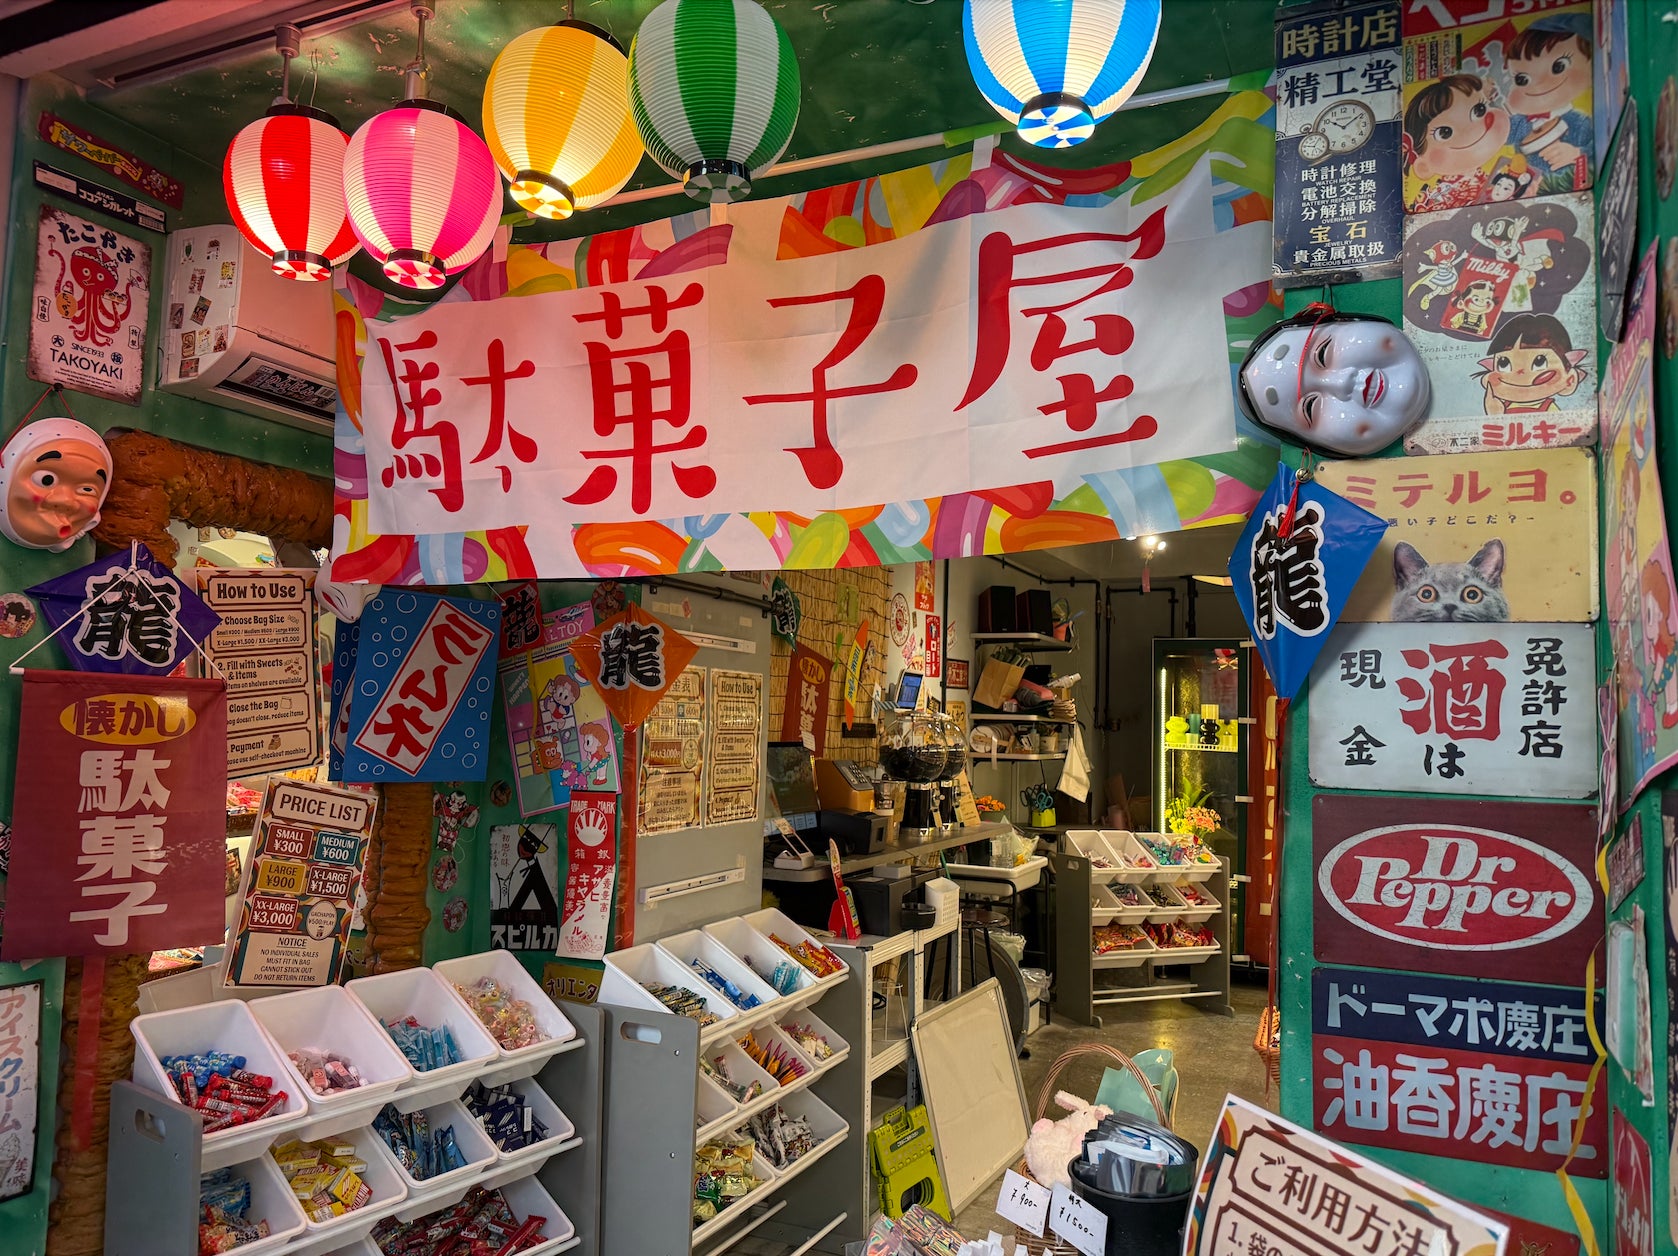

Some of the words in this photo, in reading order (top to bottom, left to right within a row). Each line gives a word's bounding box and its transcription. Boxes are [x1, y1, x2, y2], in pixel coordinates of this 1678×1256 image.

[1282, 8, 1399, 59] 時計店
[1283, 59, 1398, 109] 精工堂
[1301, 159, 1377, 182] 時計修理
[1315, 178, 1338, 187] WATCH
[1339, 175, 1362, 184] REPAIR
[1301, 179, 1377, 201] 電池交換
[79, 188, 135, 217] ココアシガレット
[1301, 200, 1330, 208] BATTERY
[1330, 193, 1377, 204] REPLACEMENT
[1301, 199, 1377, 222] 分解掃除
[1322, 216, 1356, 225] OVERHAUL
[1309, 220, 1368, 244] 宝石
[57, 222, 136, 264] たこやき
[1324, 239, 1353, 248] JEWELRY
[1293, 241, 1385, 265] 貴金属取扱
[1309, 259, 1341, 268] PRECIOUS
[1341, 257, 1367, 265] METALS
[1466, 257, 1511, 283] Milky
[50, 347, 124, 380] TAKOYAKI
[377, 205, 1168, 515] 駄菓子屋
[1482, 420, 1582, 447] ミルキー
[1252, 501, 1329, 639] 龍
[217, 583, 249, 599] How
[250, 583, 267, 599] to
[269, 583, 296, 598] Use
[75, 567, 180, 666] 龍
[225, 616, 252, 626] Choose
[253, 615, 268, 626] Bag
[269, 614, 285, 624] Size
[557, 620, 585, 637] TOY
[218, 662, 226, 671] 2.
[227, 661, 239, 670] Fill
[239, 659, 256, 670] with
[256, 658, 283, 668] Sweets
[235, 670, 257, 680] Items
[248, 680, 268, 688] shelves
[278, 676, 302, 684] available
[373, 612, 484, 758] ラムネ
[721, 681, 734, 693] How
[1518, 637, 1568, 759] 免許店
[229, 702, 249, 713] Close
[249, 701, 263, 710] the
[263, 700, 279, 710] Bag
[75, 700, 186, 737] 懐かし
[230, 740, 265, 753] Payment
[249, 751, 284, 762] self-checkout
[279, 793, 327, 816] PRICE
[329, 802, 362, 822] LIST
[570, 800, 588, 813] TRADE
[597, 800, 616, 814] MARK
[276, 829, 305, 842] SMALL
[321, 836, 355, 849] MEDIUM
[69, 749, 171, 946] 駄菓子
[273, 839, 304, 854] ¥300
[322, 846, 350, 861] ¥600
[1409, 835, 1518, 885] Dr
[269, 863, 298, 876] LARGE
[312, 870, 348, 883] X-LARGE
[266, 874, 295, 889] ¥900
[310, 880, 346, 895] ¥1,500
[591, 864, 604, 902] アサヒ
[1345, 855, 1571, 933] Pepper
[255, 900, 296, 912] XX-LARGE
[252, 911, 294, 926] ¥3,000
[278, 936, 307, 947] NOTICE
[270, 949, 302, 957] INDIVIDUAL
[260, 965, 283, 973] CANNOT
[299, 958, 310, 966] BAG
